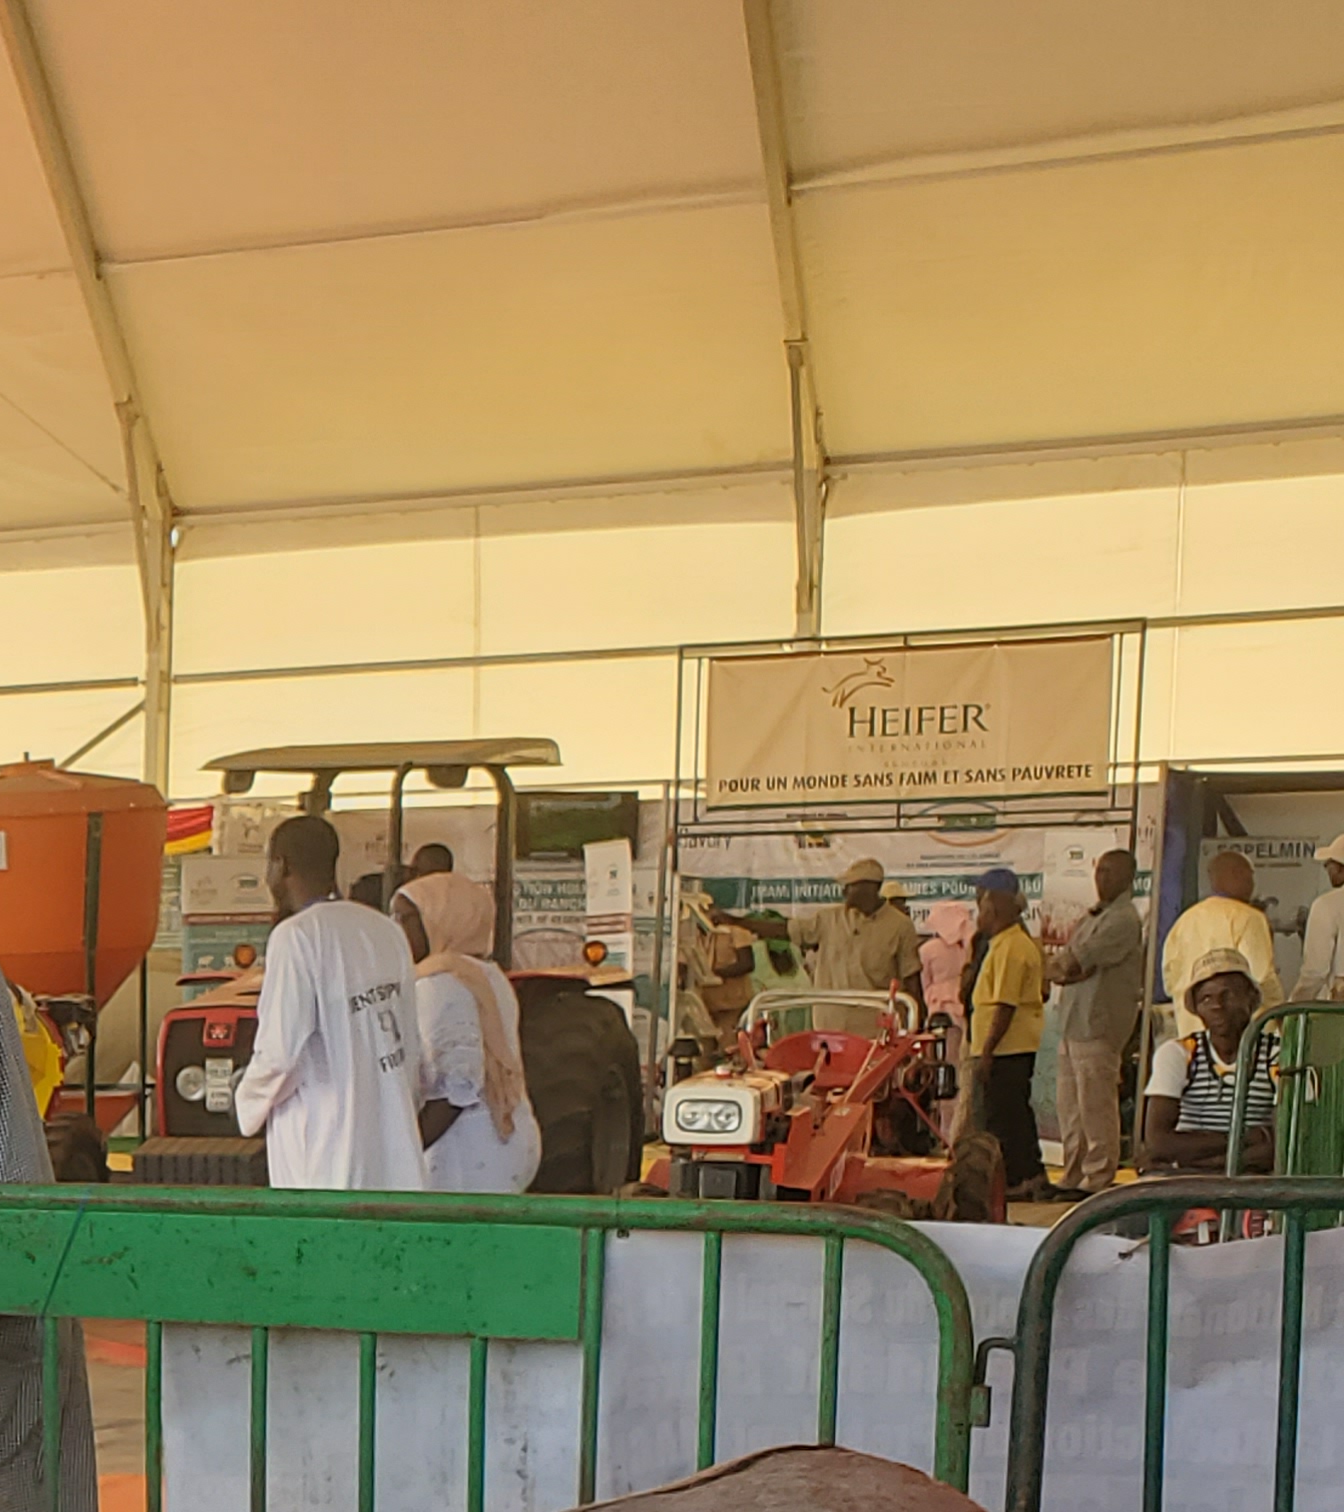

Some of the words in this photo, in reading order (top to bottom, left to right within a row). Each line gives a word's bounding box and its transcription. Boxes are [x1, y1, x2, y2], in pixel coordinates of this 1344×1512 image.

[847, 703, 989, 738] HEIFER
[847, 739, 987, 754] INTERNATIONAL
[718, 778, 761, 793] POUR
[766, 776, 788, 791] UN
[792, 774, 849, 790] MONDE
[853, 771, 894, 788] SANS
[899, 770, 938, 787] FAIM
[943, 768, 960, 785] ET
[964, 767, 1007, 784] SANS
[1011, 764, 1095, 782] PAUVRETE
